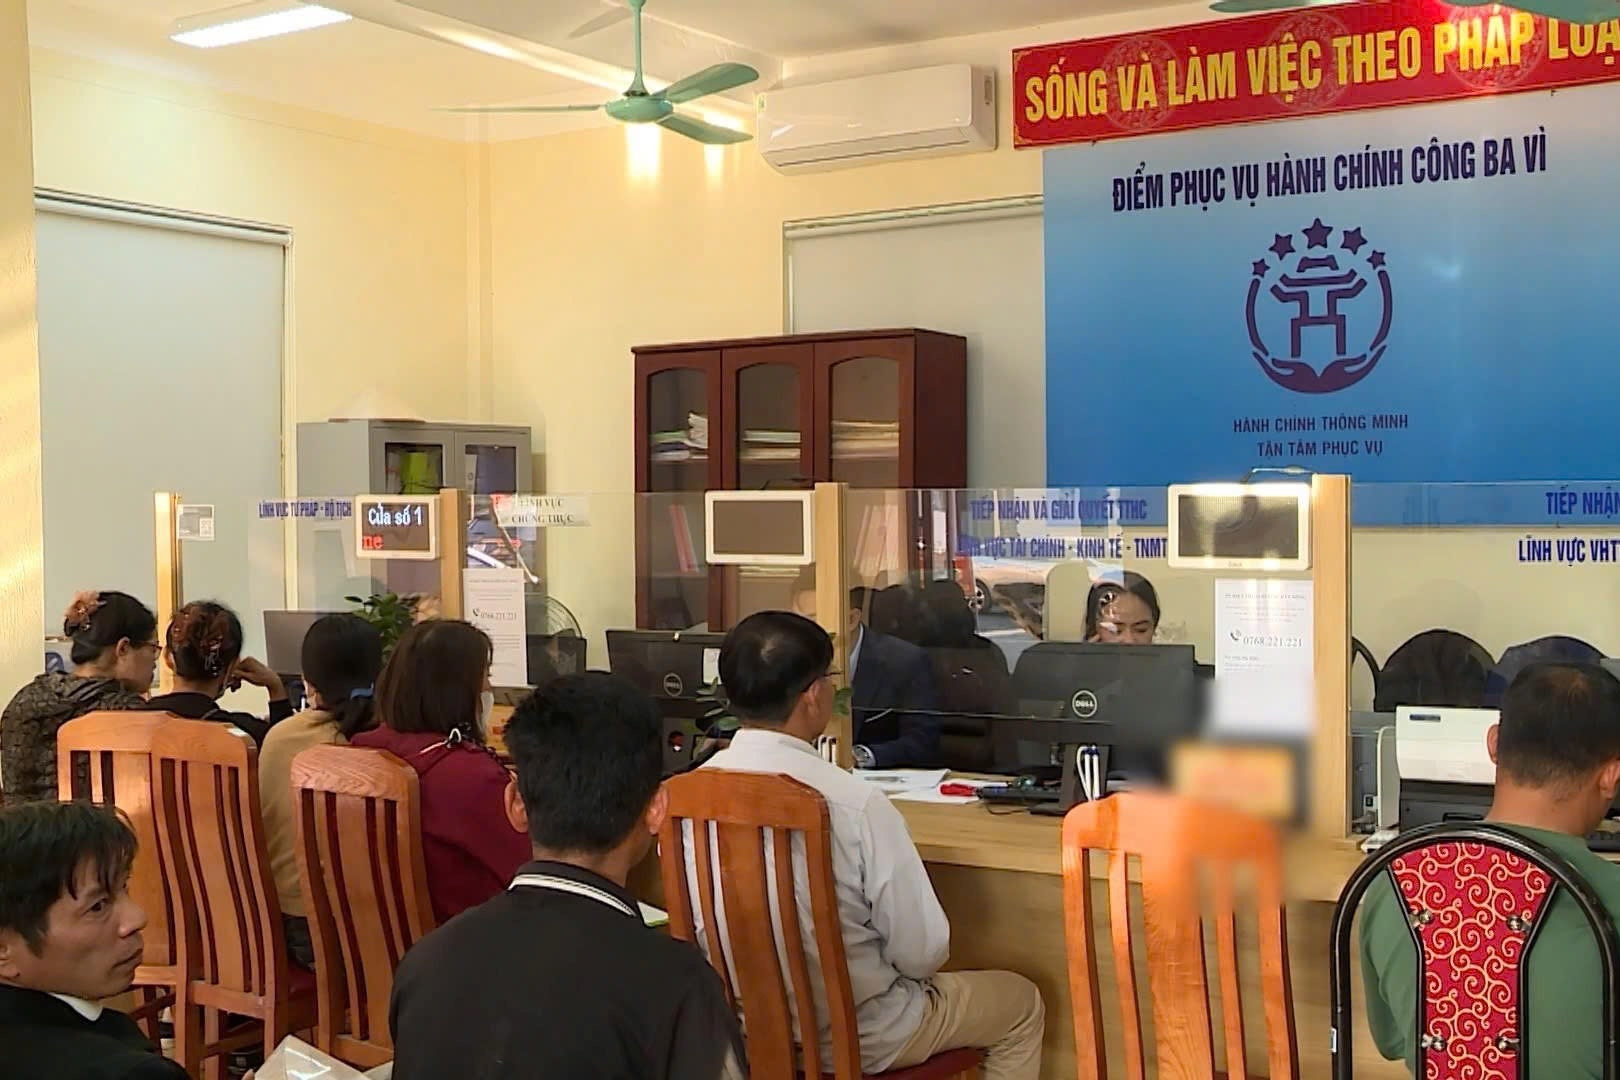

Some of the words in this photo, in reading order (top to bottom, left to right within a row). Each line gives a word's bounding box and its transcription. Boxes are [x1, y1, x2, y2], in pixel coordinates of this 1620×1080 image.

[1025, 57, 1108, 122] SỐNG
[1117, 52, 1158, 112] VÀ
[1167, 46, 1237, 106] LÀM
[1247, 32, 1322, 103] VIỆC
[1333, 26, 1422, 85] THEO
[1434, 4, 1535, 74] PHÁP
[1112, 161, 1163, 212] ĐIỂM
[1170, 167, 1225, 211] PHỤC
[1232, 163, 1259, 207] VỤ
[1266, 152, 1326, 197] HÀNH
[1334, 144, 1403, 191] CHÍNH
[1411, 137, 1475, 183] CÔNG
[1484, 138, 1516, 177] BA
[1523, 126, 1546, 173] VÌ
[1233, 416, 1269, 433] HÀNH
[1275, 414, 1316, 432] CHÍNH
[1321, 413, 1366, 431] THÔNG
[1372, 414, 1408, 429] MINH
[1288, 438, 1317, 456] TÂM
[1322, 440, 1359, 458] PHỤC
[1365, 440, 1383, 457] VỤ
[368, 502, 392, 525] Cửa
[395, 504, 411, 525] số
[414, 506, 422, 525] 1
[970, 494, 995, 520] TIẾP
[998, 496, 1030, 522] NHẬN
[1033, 496, 1048, 520] VÀ
[1051, 491, 1075, 520] GIẢI
[1545, 484, 1578, 515] TIẾP
[1009, 533, 1026, 558] TÀI
[1030, 533, 1065, 558] CHÍNH
[1076, 537, 1105, 558] KINH
[1109, 532, 1123, 558] TẾ
[1134, 538, 1168, 558] TNMT
[1519, 534, 1552, 562] LĨNH
[1556, 537, 1586, 567] VỰC
